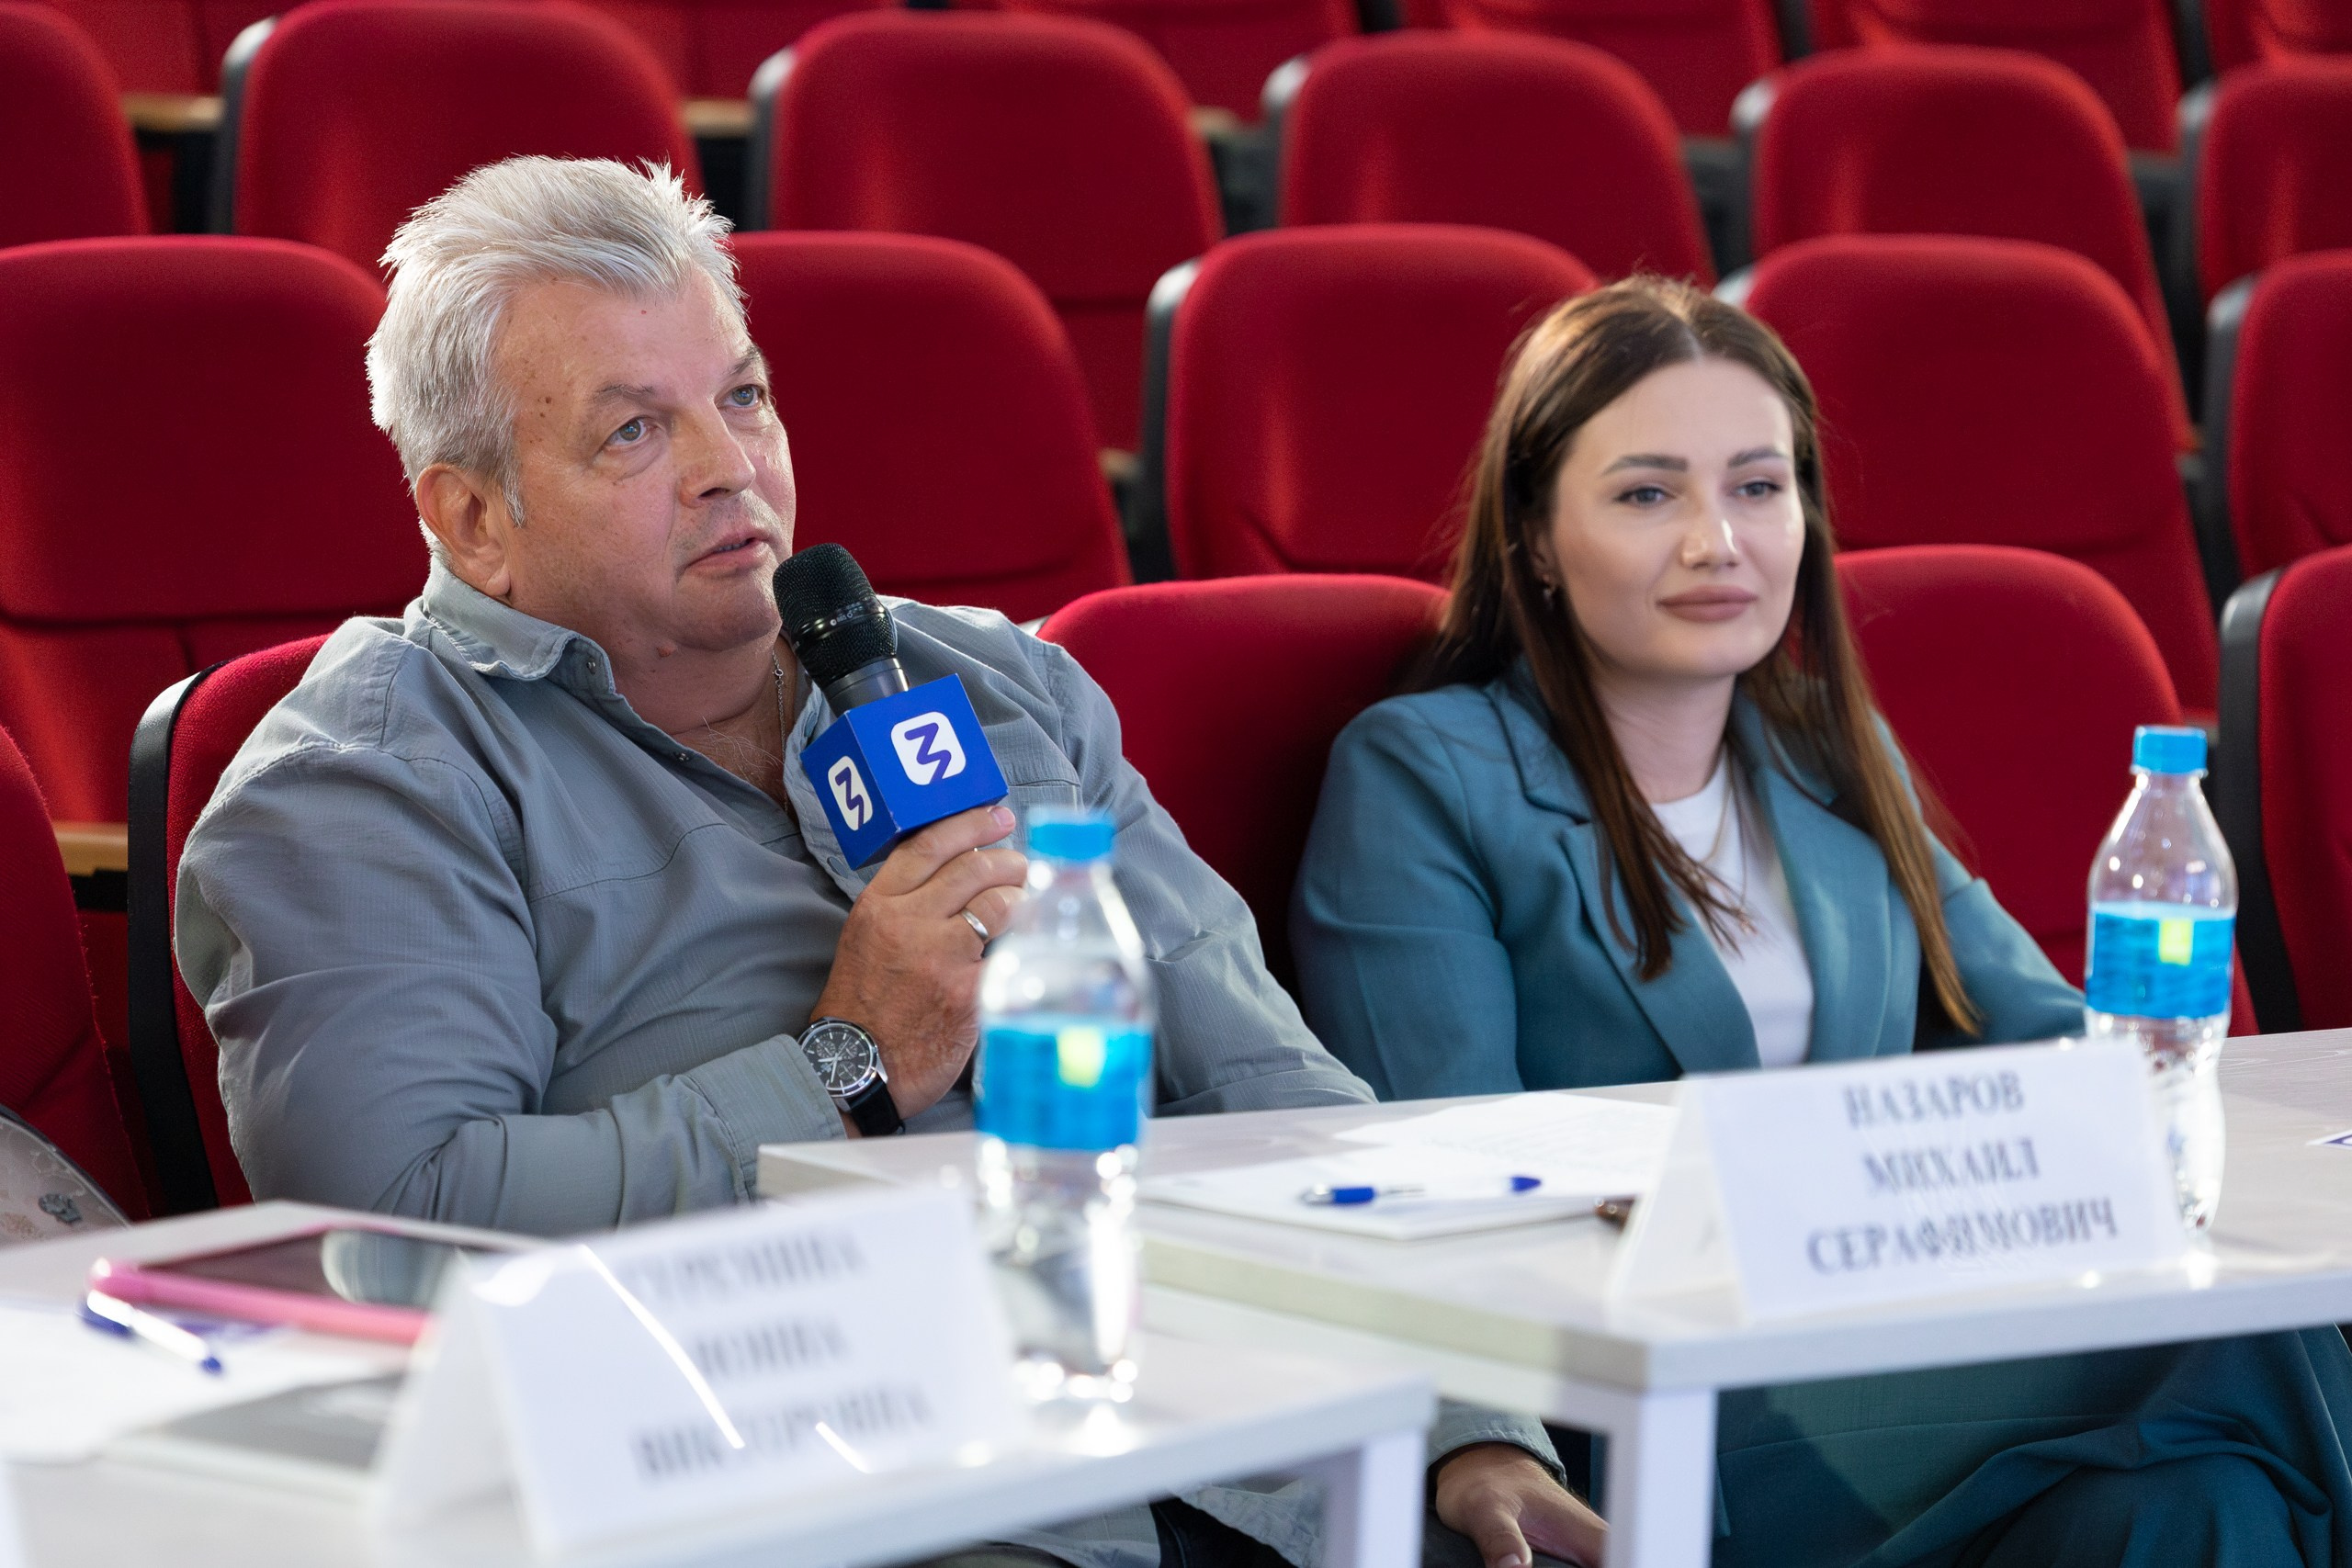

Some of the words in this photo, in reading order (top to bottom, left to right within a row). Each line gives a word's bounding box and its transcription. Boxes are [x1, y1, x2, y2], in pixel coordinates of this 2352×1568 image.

[1842, 1069, 2026, 1131] НАЗАРОВ
[1862, 1135, 2041, 1197] МИХАИЛ
[1805, 1196, 2119, 1275] СЕРАФИМОВИЧ
